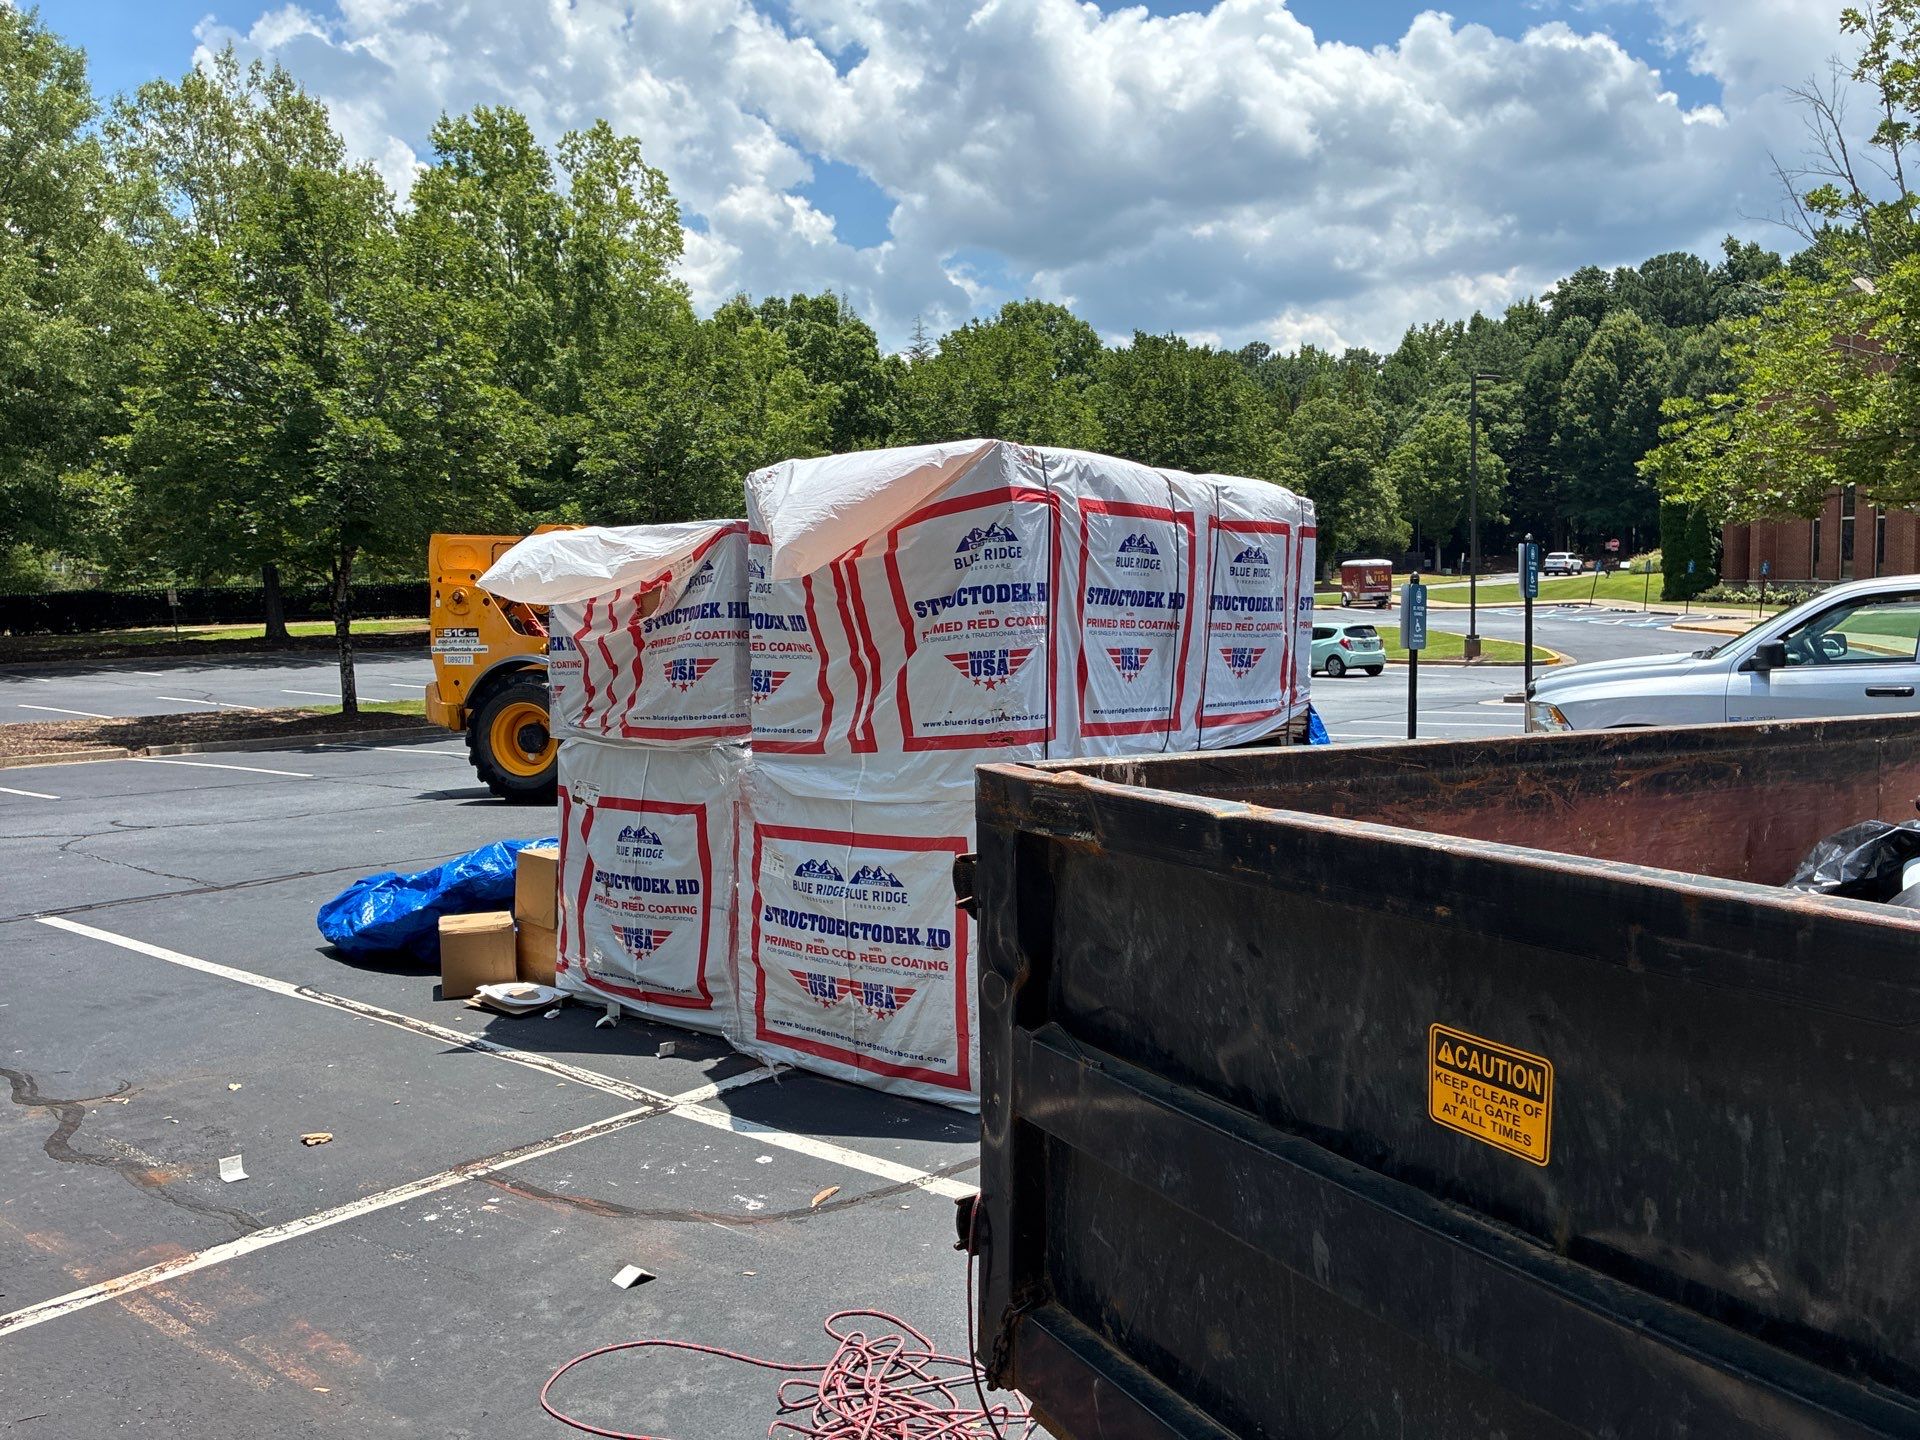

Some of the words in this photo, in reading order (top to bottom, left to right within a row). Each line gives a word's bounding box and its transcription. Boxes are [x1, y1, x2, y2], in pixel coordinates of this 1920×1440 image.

[984, 546, 1022, 561] RIDGE
[1116, 556, 1135, 568] BLUE
[1136, 558, 1161, 570] RIDGE
[1230, 567, 1251, 577] BLUE
[1253, 567, 1270, 578] RIDGE
[1087, 586, 1166, 609] STRUCTODEK
[1167, 592, 1186, 610] HD
[727, 601, 749, 619] HD
[787, 614, 807, 632] HD
[967, 618, 1000, 631] RED
[1086, 618, 1118, 629] PRIMED
[1120, 619, 1136, 629] RED
[1138, 620, 1180, 631] COATING
[1234, 622, 1254, 632] RED
[1256, 622, 1282, 632] COATING
[694, 630, 749, 640] COATING
[972, 629, 1018, 639] TRADITIONAL
[769, 642, 814, 653] COATING
[969, 650, 991, 660] MADE
[998, 649, 1009, 659] IN
[672, 658, 687, 667] MADE
[689, 657, 697, 666] IN
[970, 658, 1010, 677] USA
[1121, 655, 1140, 671] USA
[1231, 655, 1252, 669] USA
[671, 665, 696, 681] USA
[764, 669, 772, 678] IN
[676, 879, 700, 895] HD
[792, 880, 813, 895] BLUE
[872, 891, 909, 905] RIDGE
[648, 904, 698, 915] COATING
[853, 903, 897, 912] FIBERBOARD
[645, 928, 653, 936] IN
[926, 927, 951, 949] HD
[624, 934, 653, 950] USA
[764, 934, 803, 952] PRIMED
[805, 943, 830, 956] RED
[860, 952, 887, 965] RED
[891, 956, 949, 972] COATING
[807, 972, 827, 983] MADE
[828, 976, 836, 984] IN
[809, 981, 838, 1000] USA
[863, 981, 884, 992] MADE
[886, 986, 894, 994] IN
[864, 990, 897, 1010] USA
[1455, 1045, 1543, 1095] CAUTION
[1434, 1070, 1469, 1091] KEEP
[1472, 1084, 1519, 1112] CLEAR
[1523, 1103, 1543, 1119] OF
[1453, 1091, 1481, 1112] TAIL
[1484, 1104, 1521, 1128] GATE
[1442, 1102, 1459, 1117] AT
[1461, 1110, 1487, 1129] ALL
[1491, 1120, 1532, 1147] TIMES
